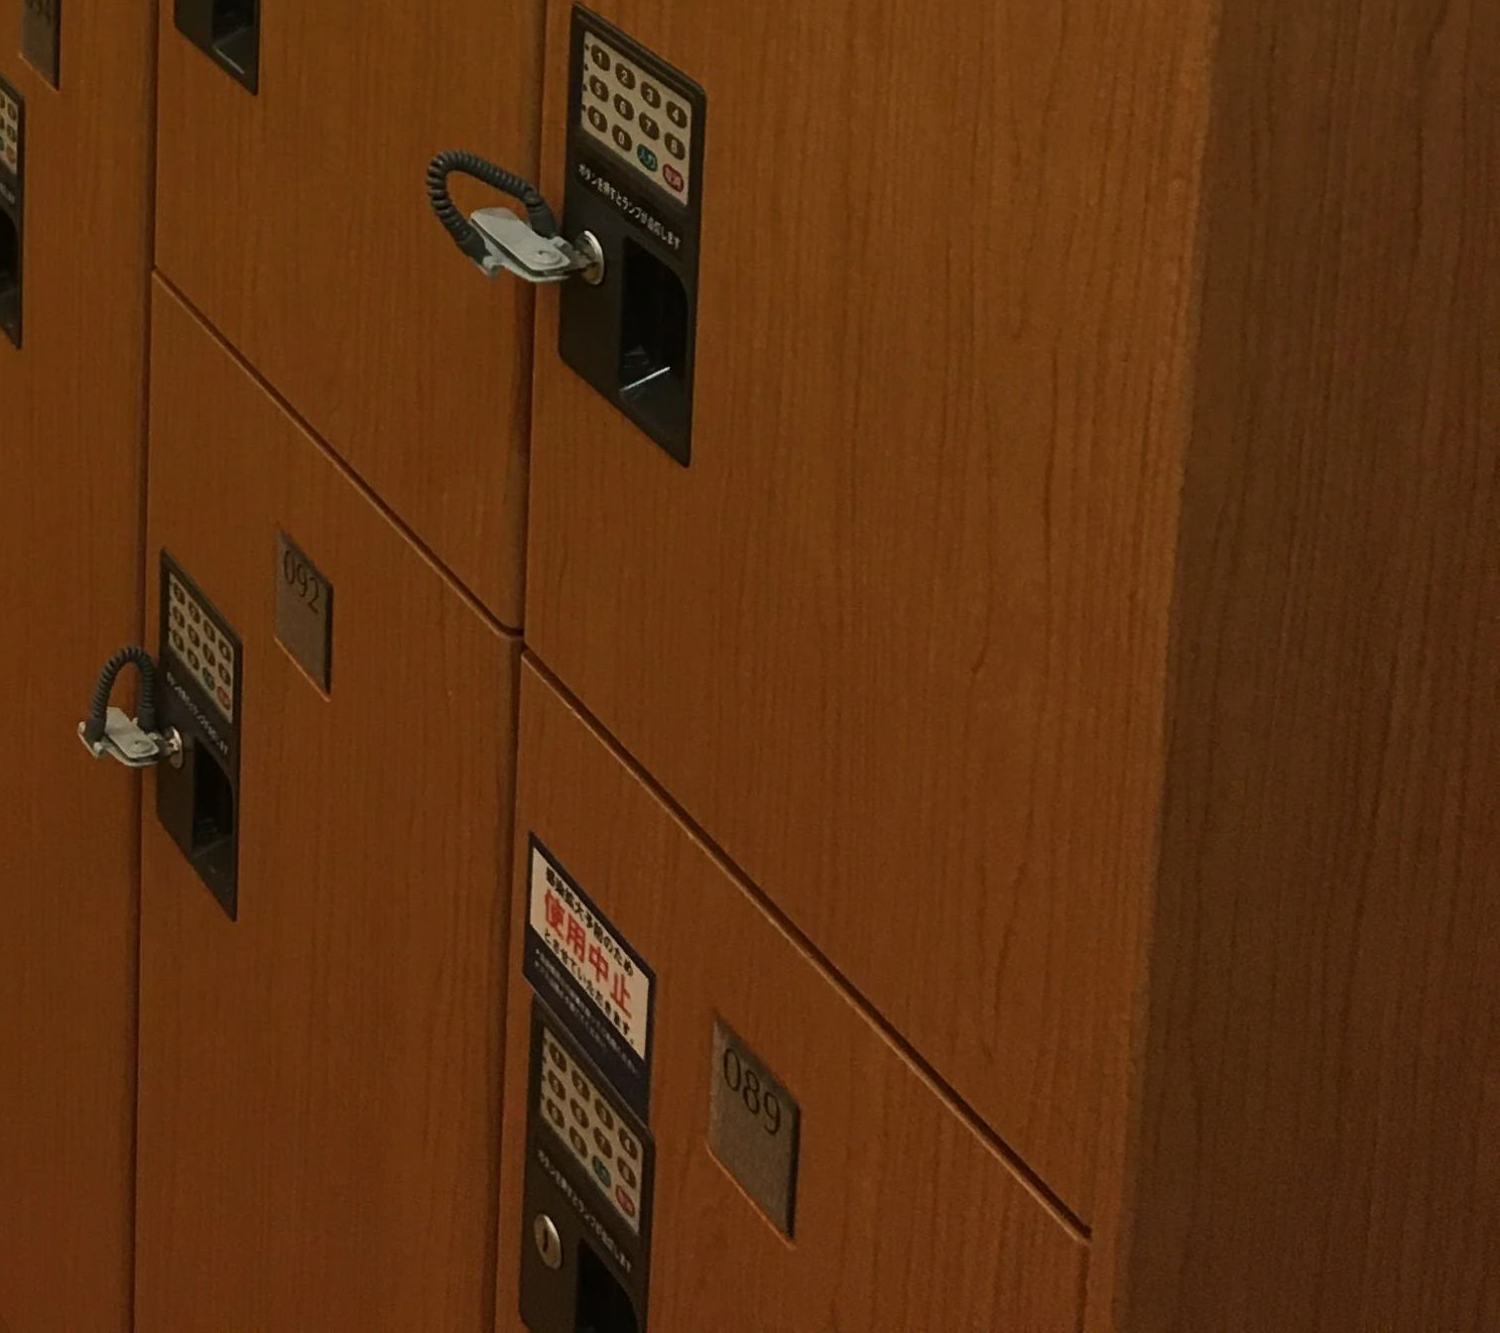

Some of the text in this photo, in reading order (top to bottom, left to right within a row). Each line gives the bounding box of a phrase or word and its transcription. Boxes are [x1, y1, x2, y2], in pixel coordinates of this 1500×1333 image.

[283, 550, 319, 614] 092
[544, 888, 632, 1020] 使用中止
[723, 1047, 782, 1136] 089
